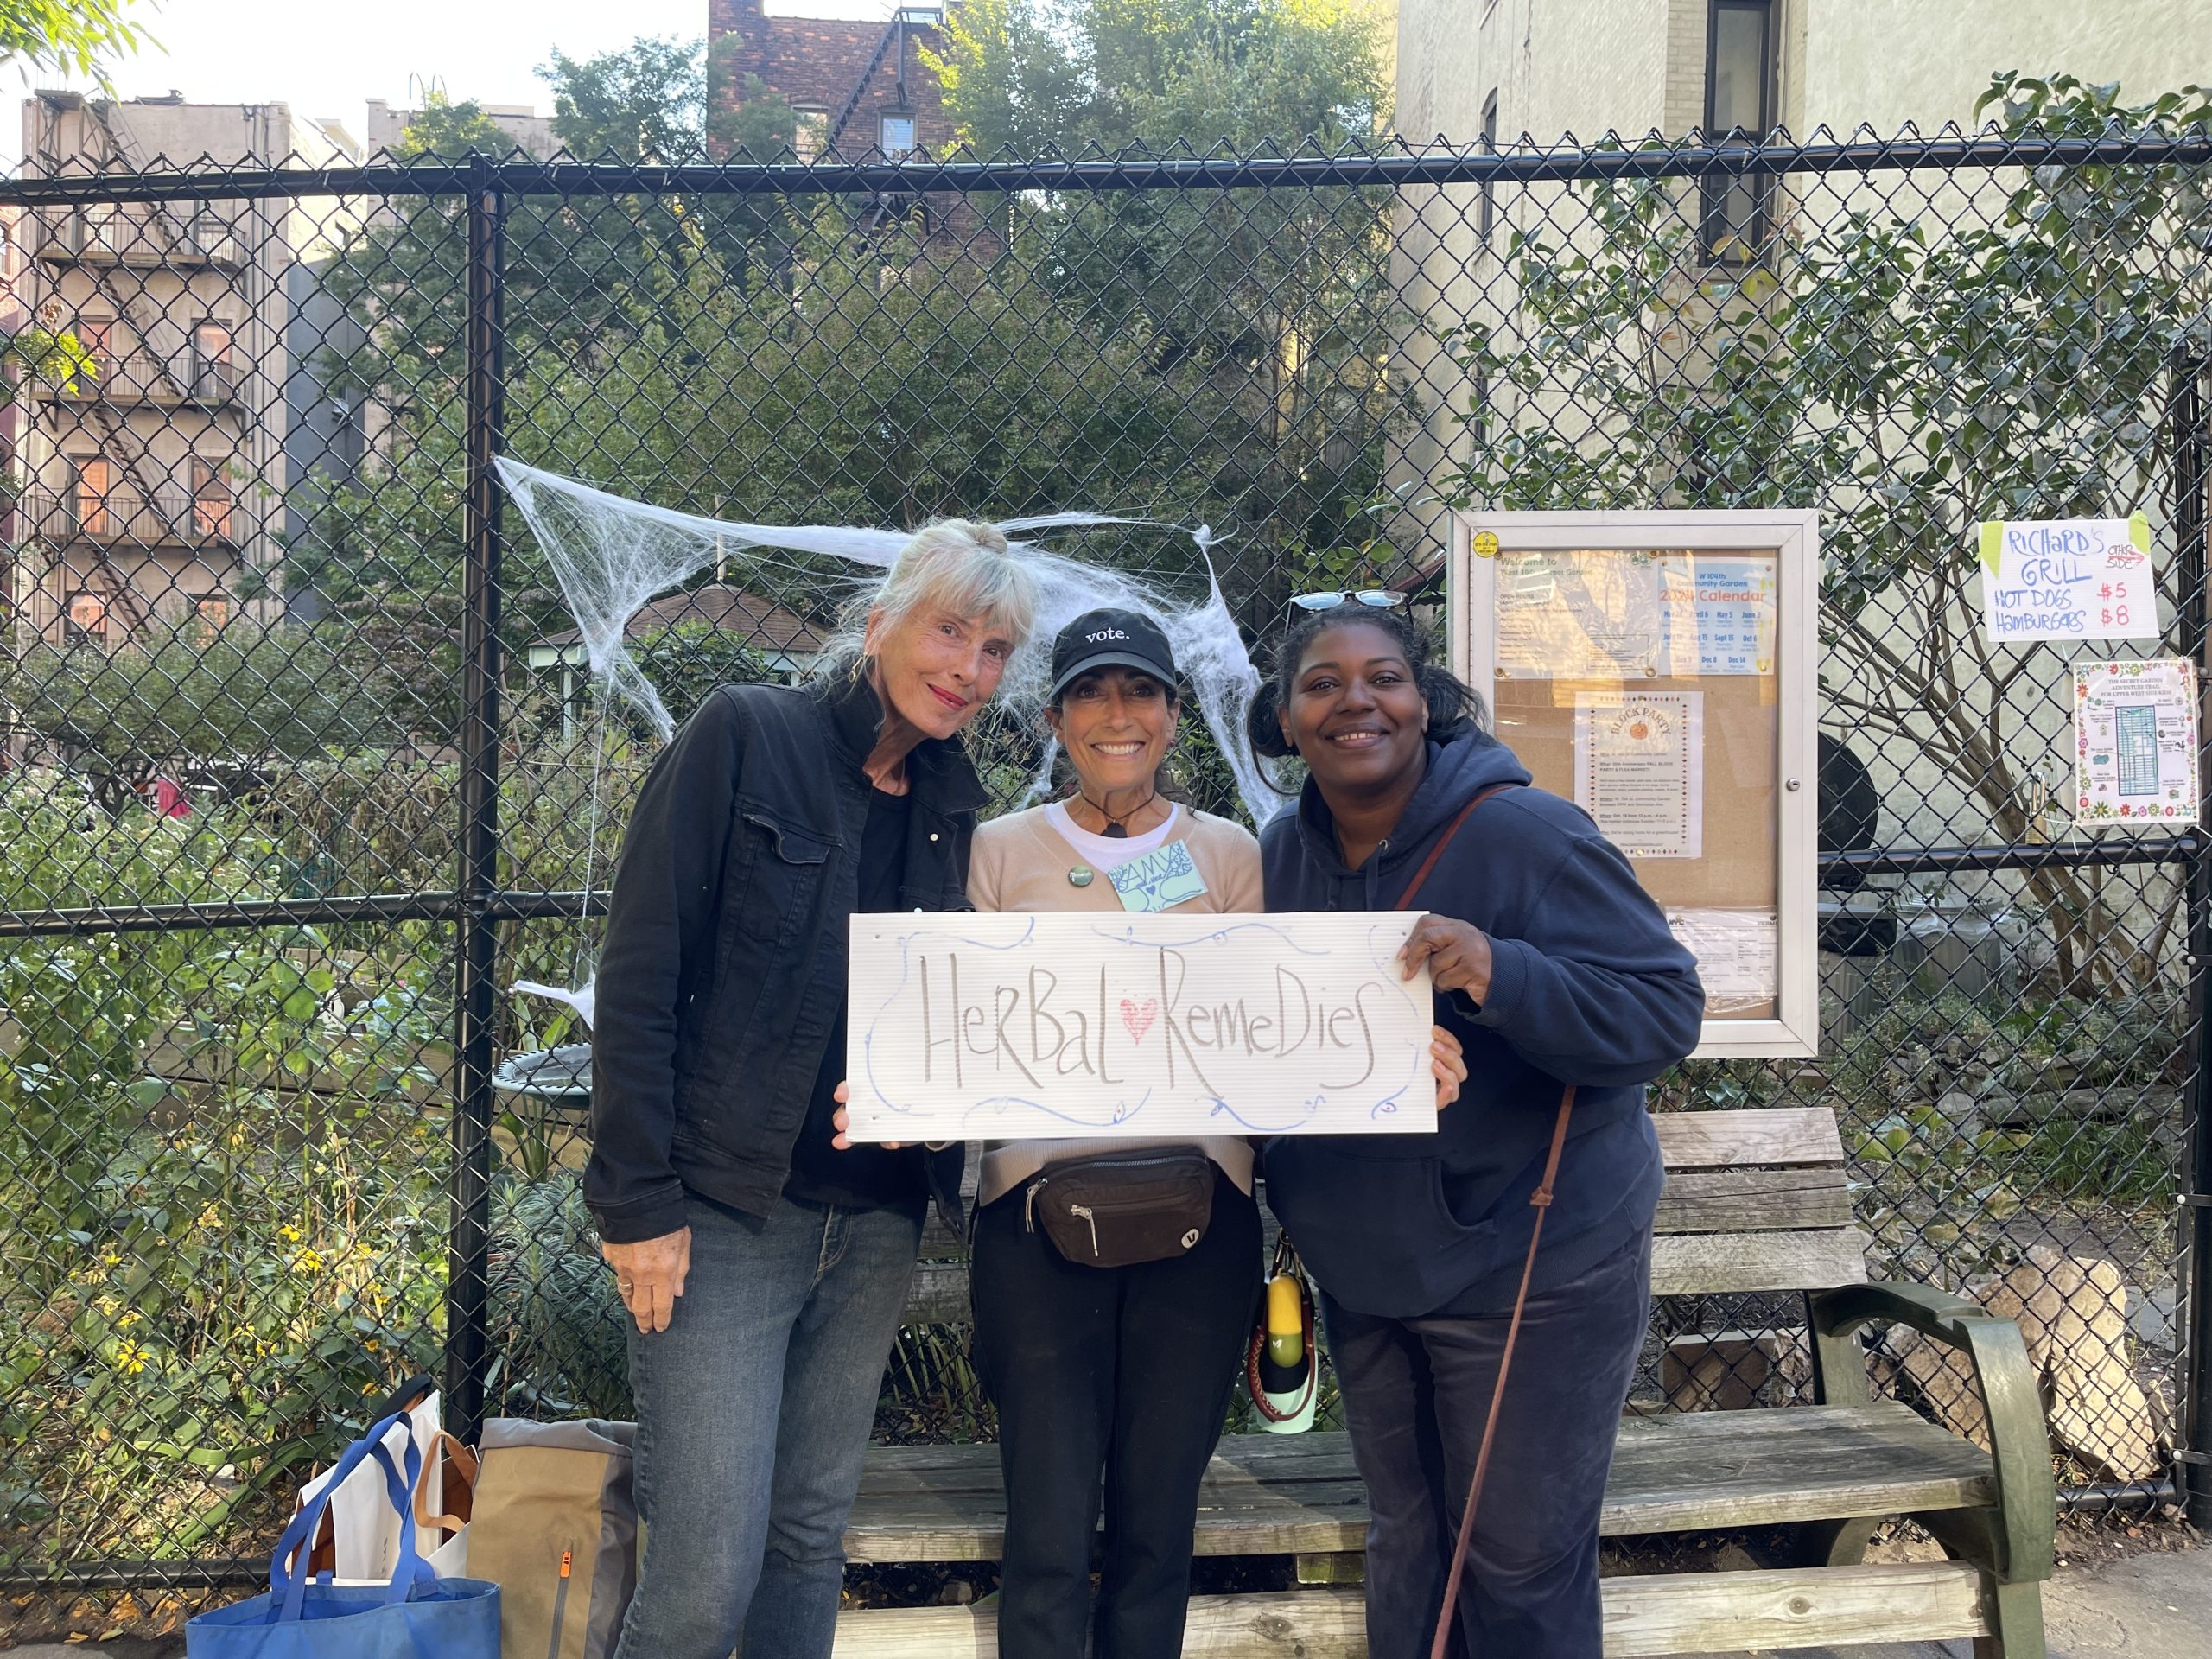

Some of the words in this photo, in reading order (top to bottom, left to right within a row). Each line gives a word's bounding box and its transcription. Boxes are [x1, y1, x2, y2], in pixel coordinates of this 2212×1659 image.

[1501, 557, 1544, 566] Welcome
[1548, 557, 1557, 566] to
[2021, 558, 2093, 587] GRILL
[1700, 589, 1767, 602] Calendar
[1994, 589, 2028, 609] HOT
[2031, 588, 2073, 610] DOGS
[1716, 611, 1728, 620] May
[1085, 626, 1131, 644] vote.
[1611, 708, 1640, 735] BLOCK
[1642, 708, 1671, 734] PARTY
[1123, 842, 1174, 892] AMY
